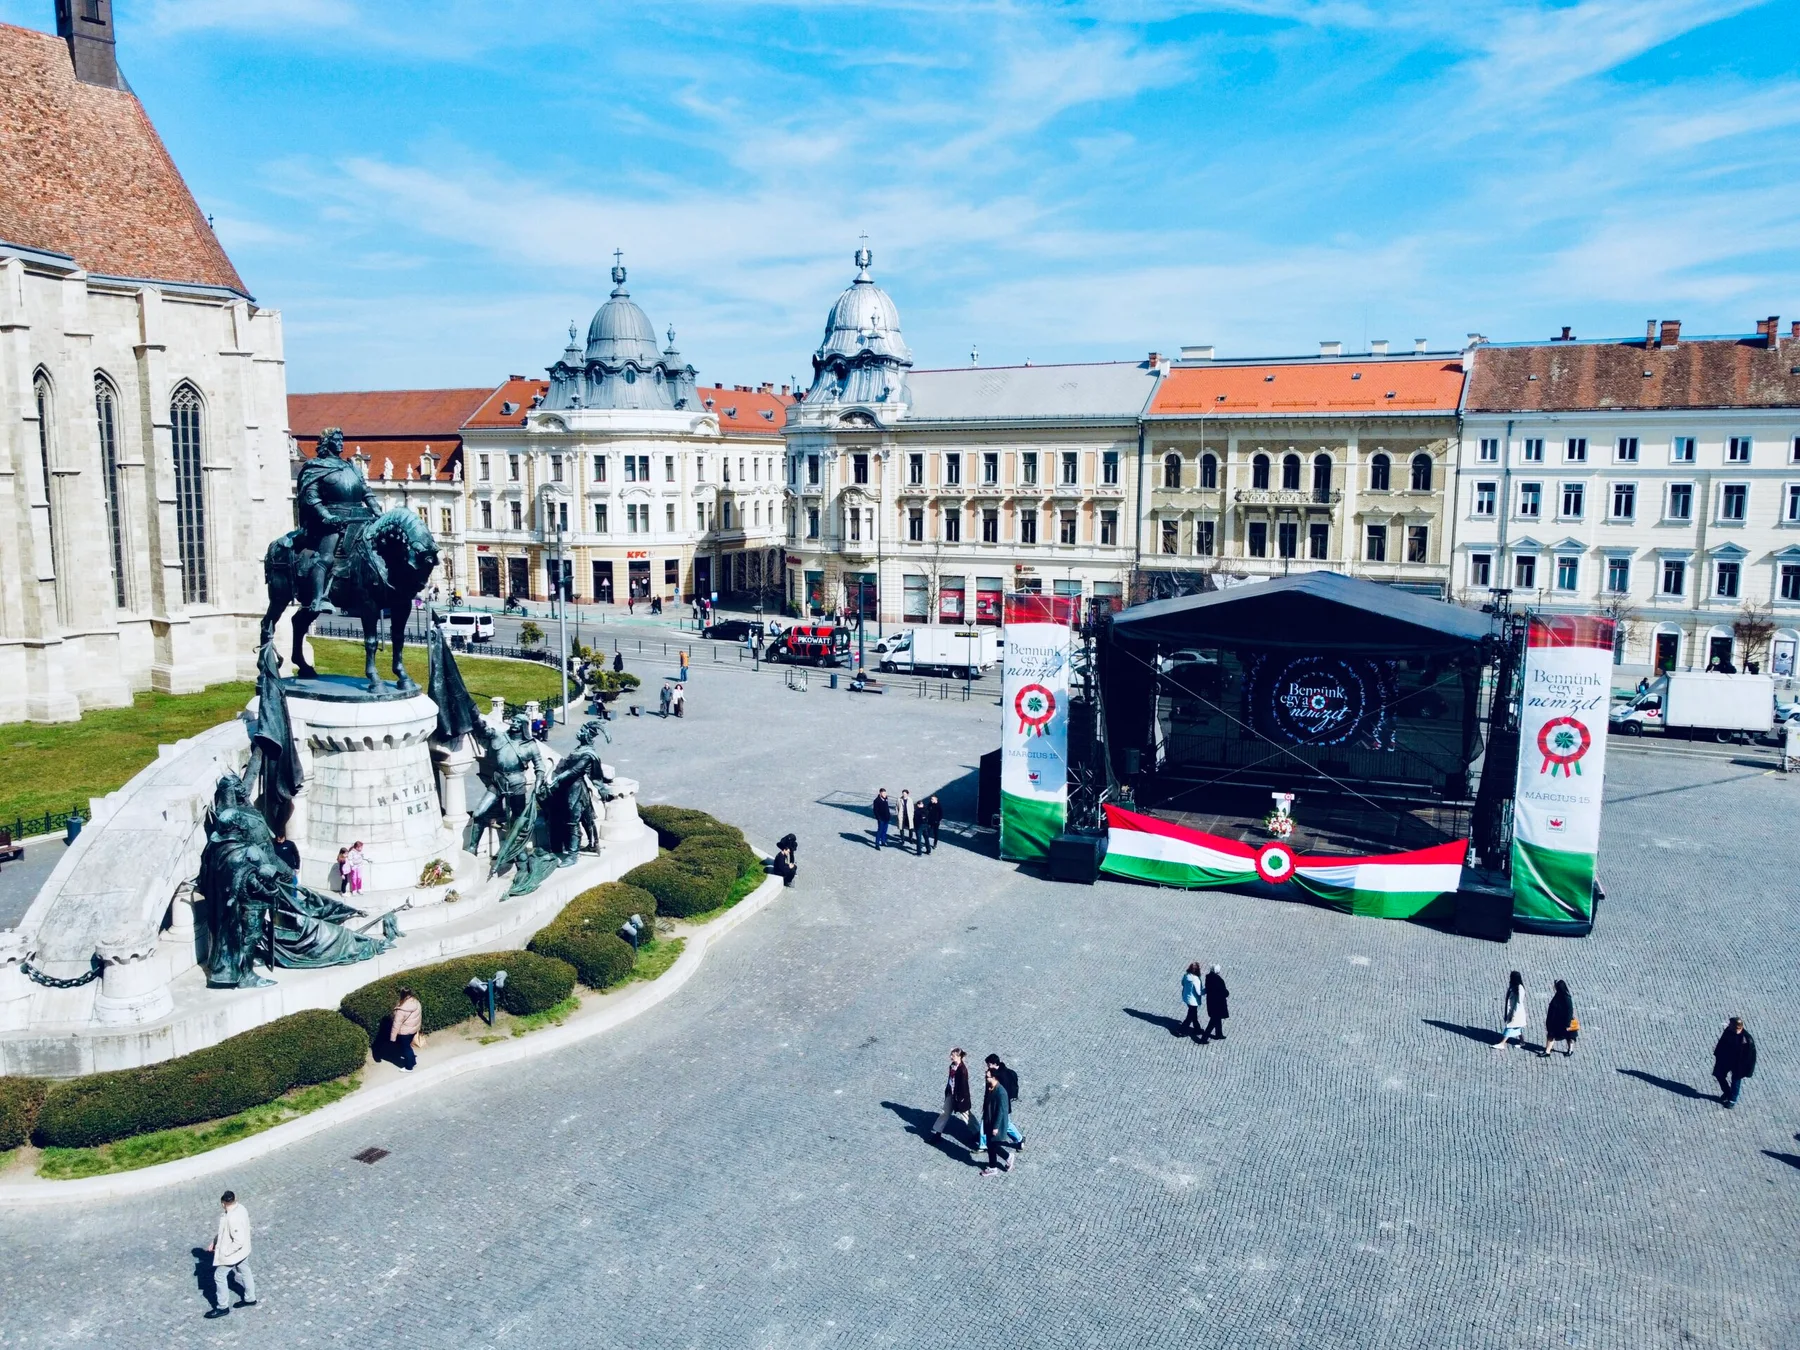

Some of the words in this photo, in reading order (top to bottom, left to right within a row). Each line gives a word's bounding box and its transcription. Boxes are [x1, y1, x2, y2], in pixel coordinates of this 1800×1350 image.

[626, 551, 647, 559] KFC
[1534, 669, 1601, 686] Bennünk
[1548, 684, 1571, 698] egy
[1576, 686, 1584, 698] a
[1280, 694, 1301, 707] egy
[1528, 695, 1602, 718] nemzet
[1290, 707, 1351, 733] nemzet
[407, 801, 429, 815] REX
